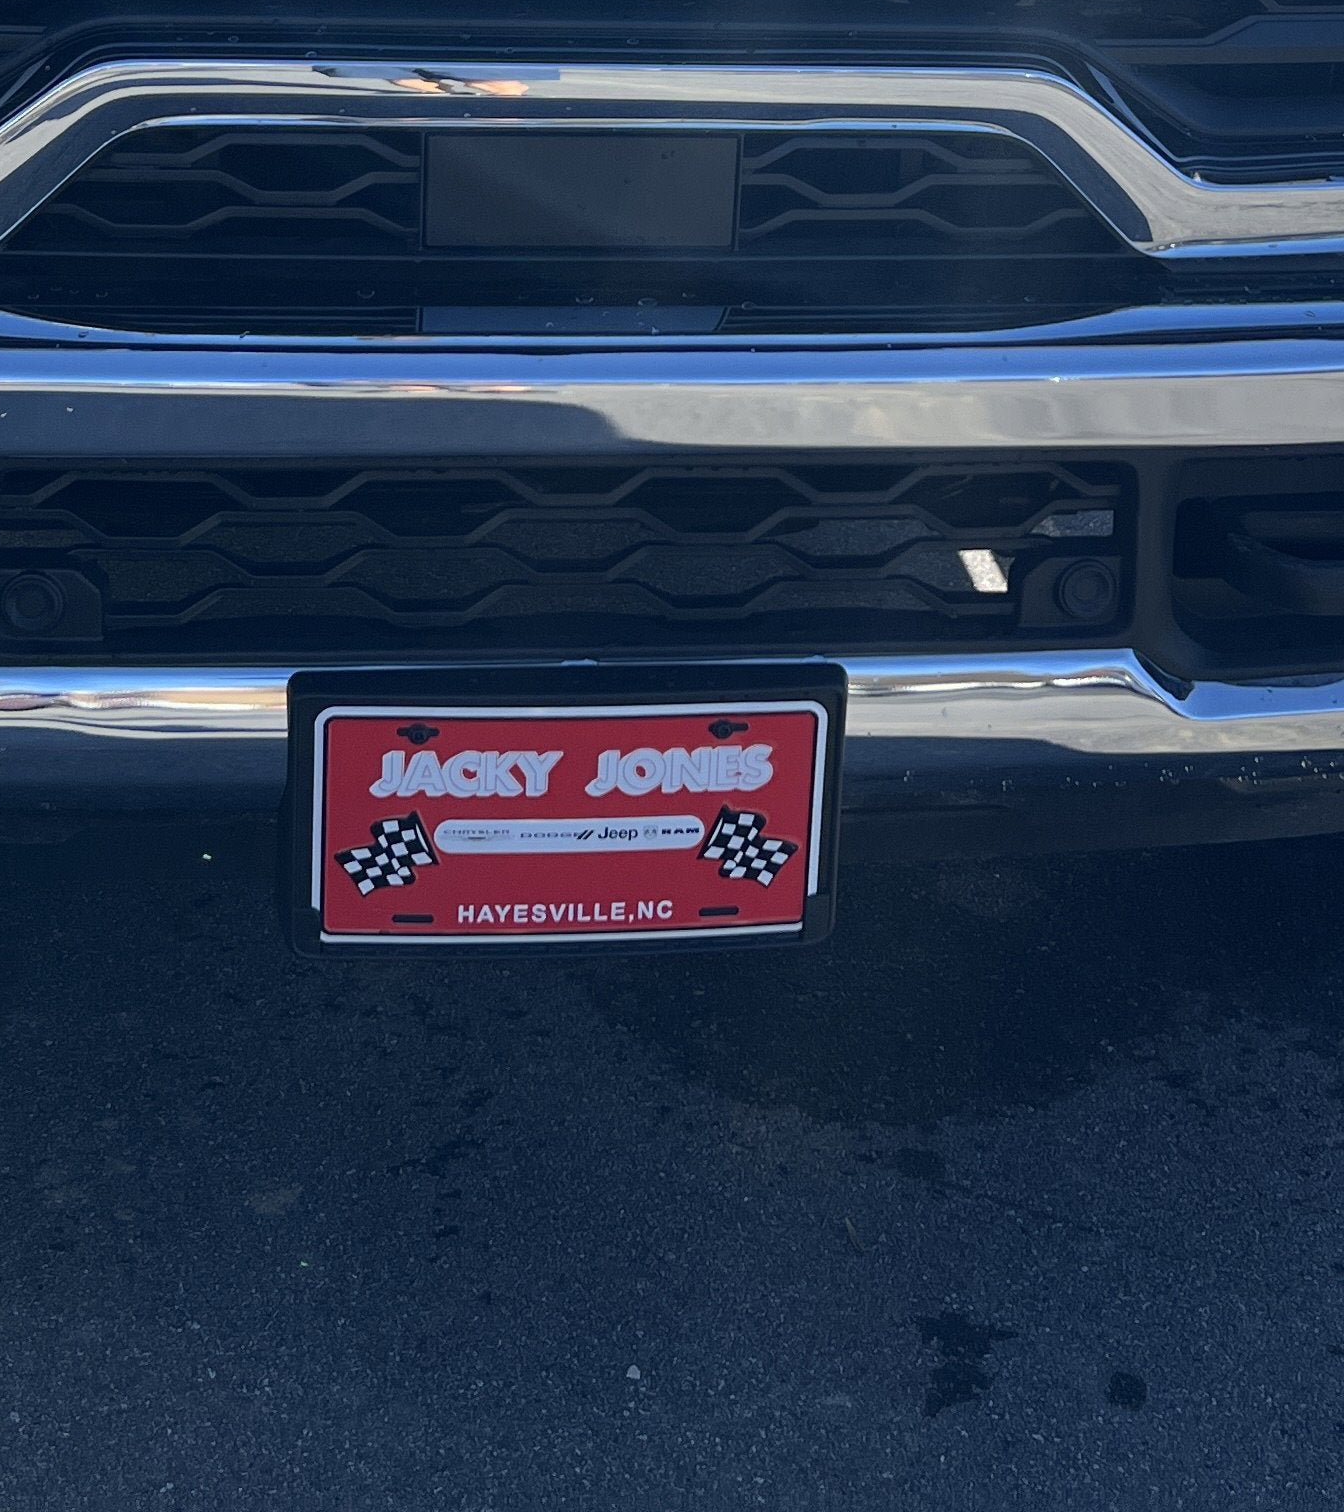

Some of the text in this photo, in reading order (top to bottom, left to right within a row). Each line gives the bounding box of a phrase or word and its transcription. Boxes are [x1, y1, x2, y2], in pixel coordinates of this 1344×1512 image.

[369, 743, 774, 799] JACKY JONES
[597, 826, 639, 841] Jeep
